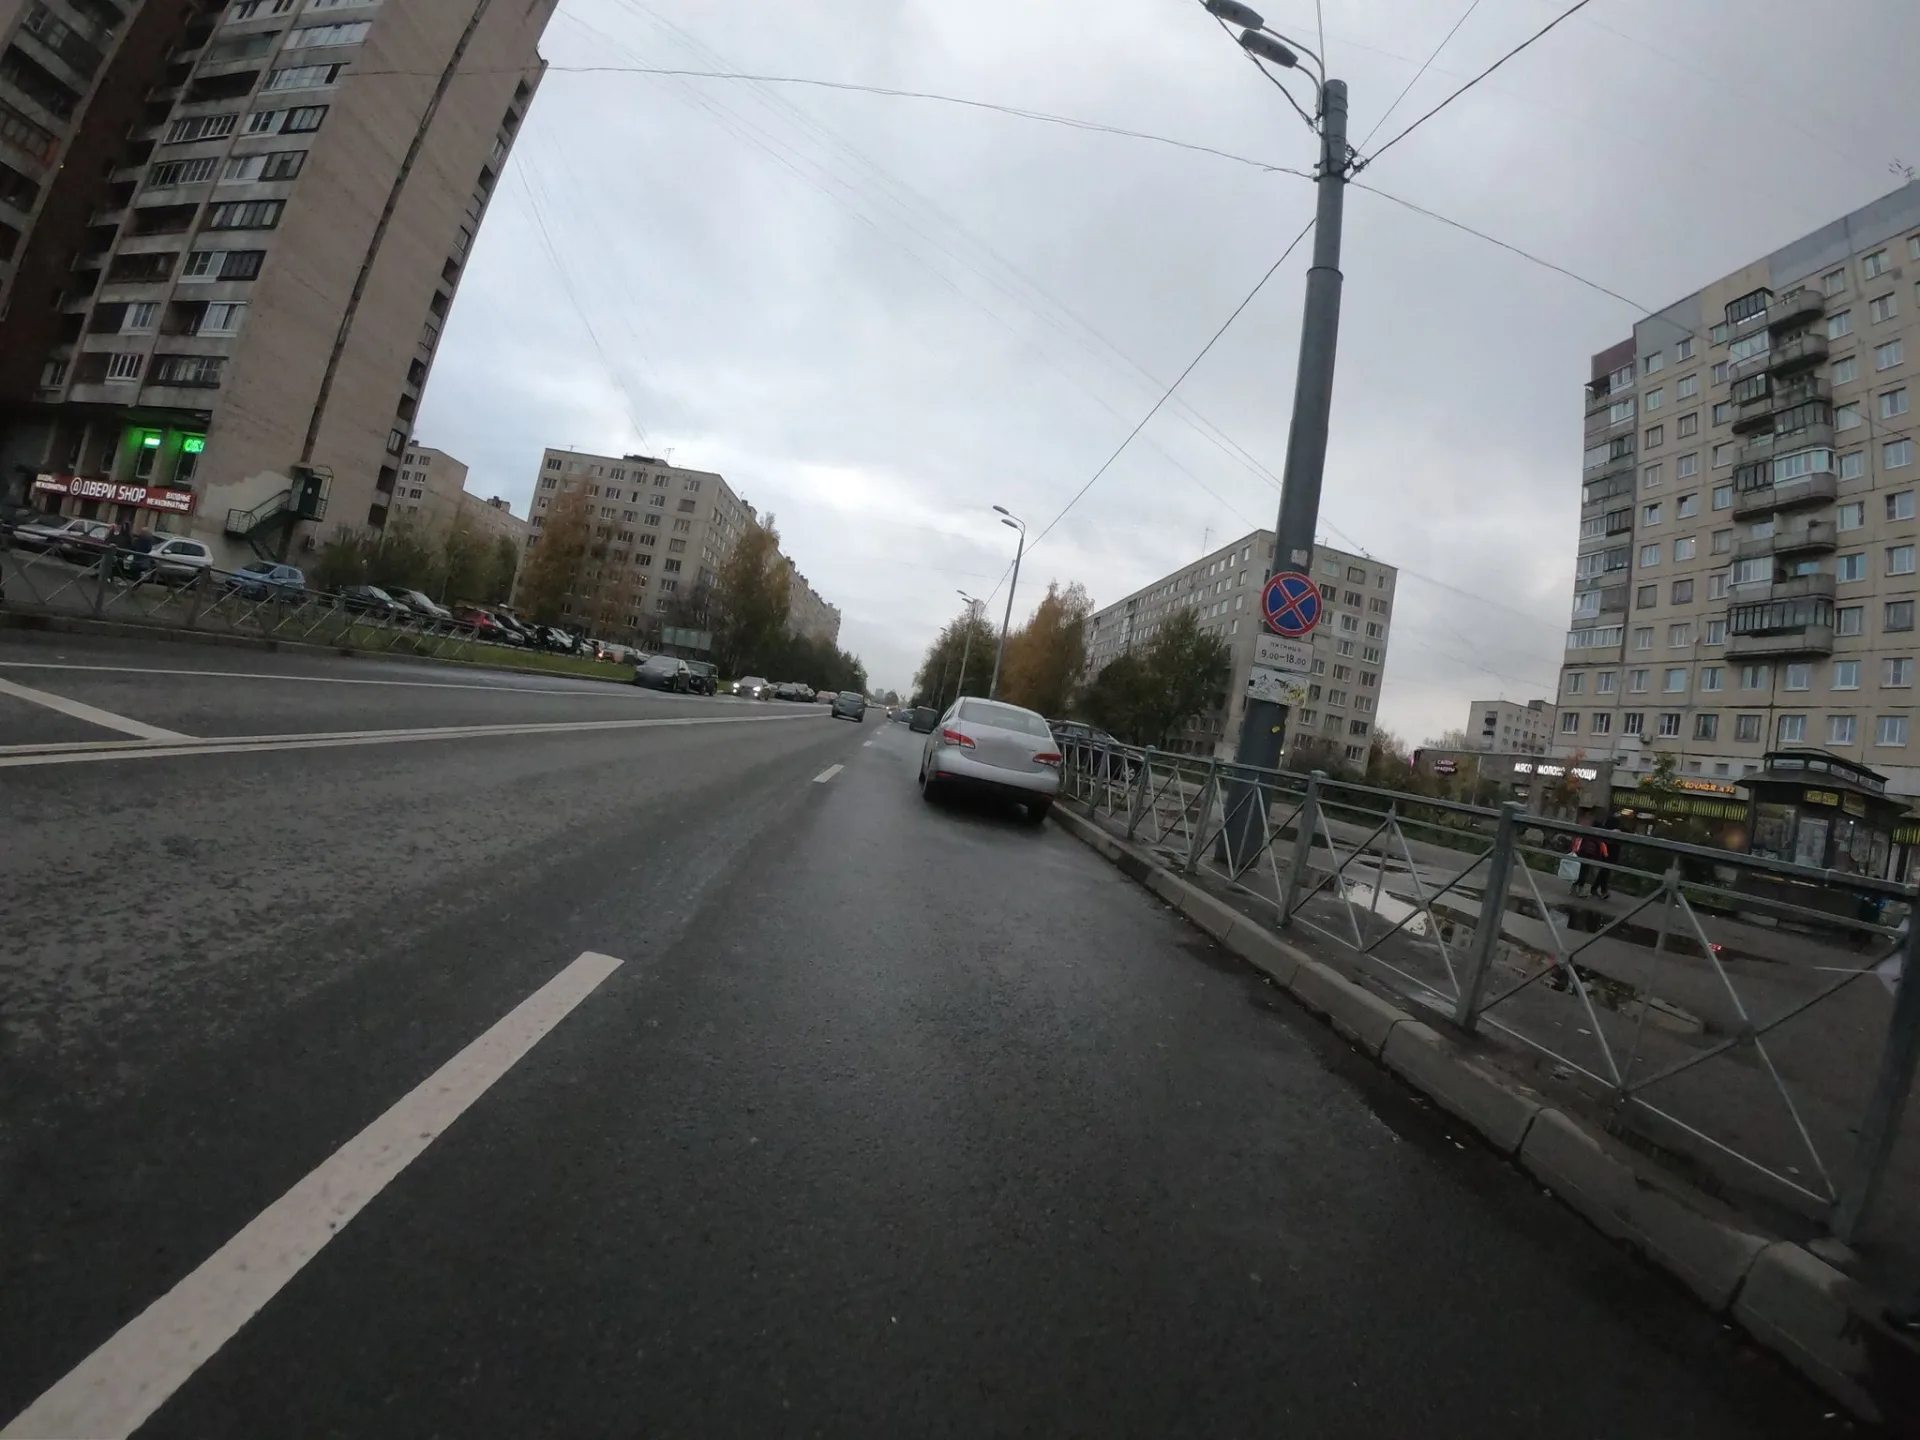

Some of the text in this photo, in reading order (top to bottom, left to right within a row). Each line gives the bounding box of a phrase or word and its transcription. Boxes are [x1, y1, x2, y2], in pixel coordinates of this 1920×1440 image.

[81, 481, 147, 503] ДВЕРИ SHOP
[166, 492, 192, 502] ВХОДНЫЕ
[146, 498, 190, 510] МЕЖКОМНАТНЫЕ
[1514, 762, 1533, 774] МЯСО
